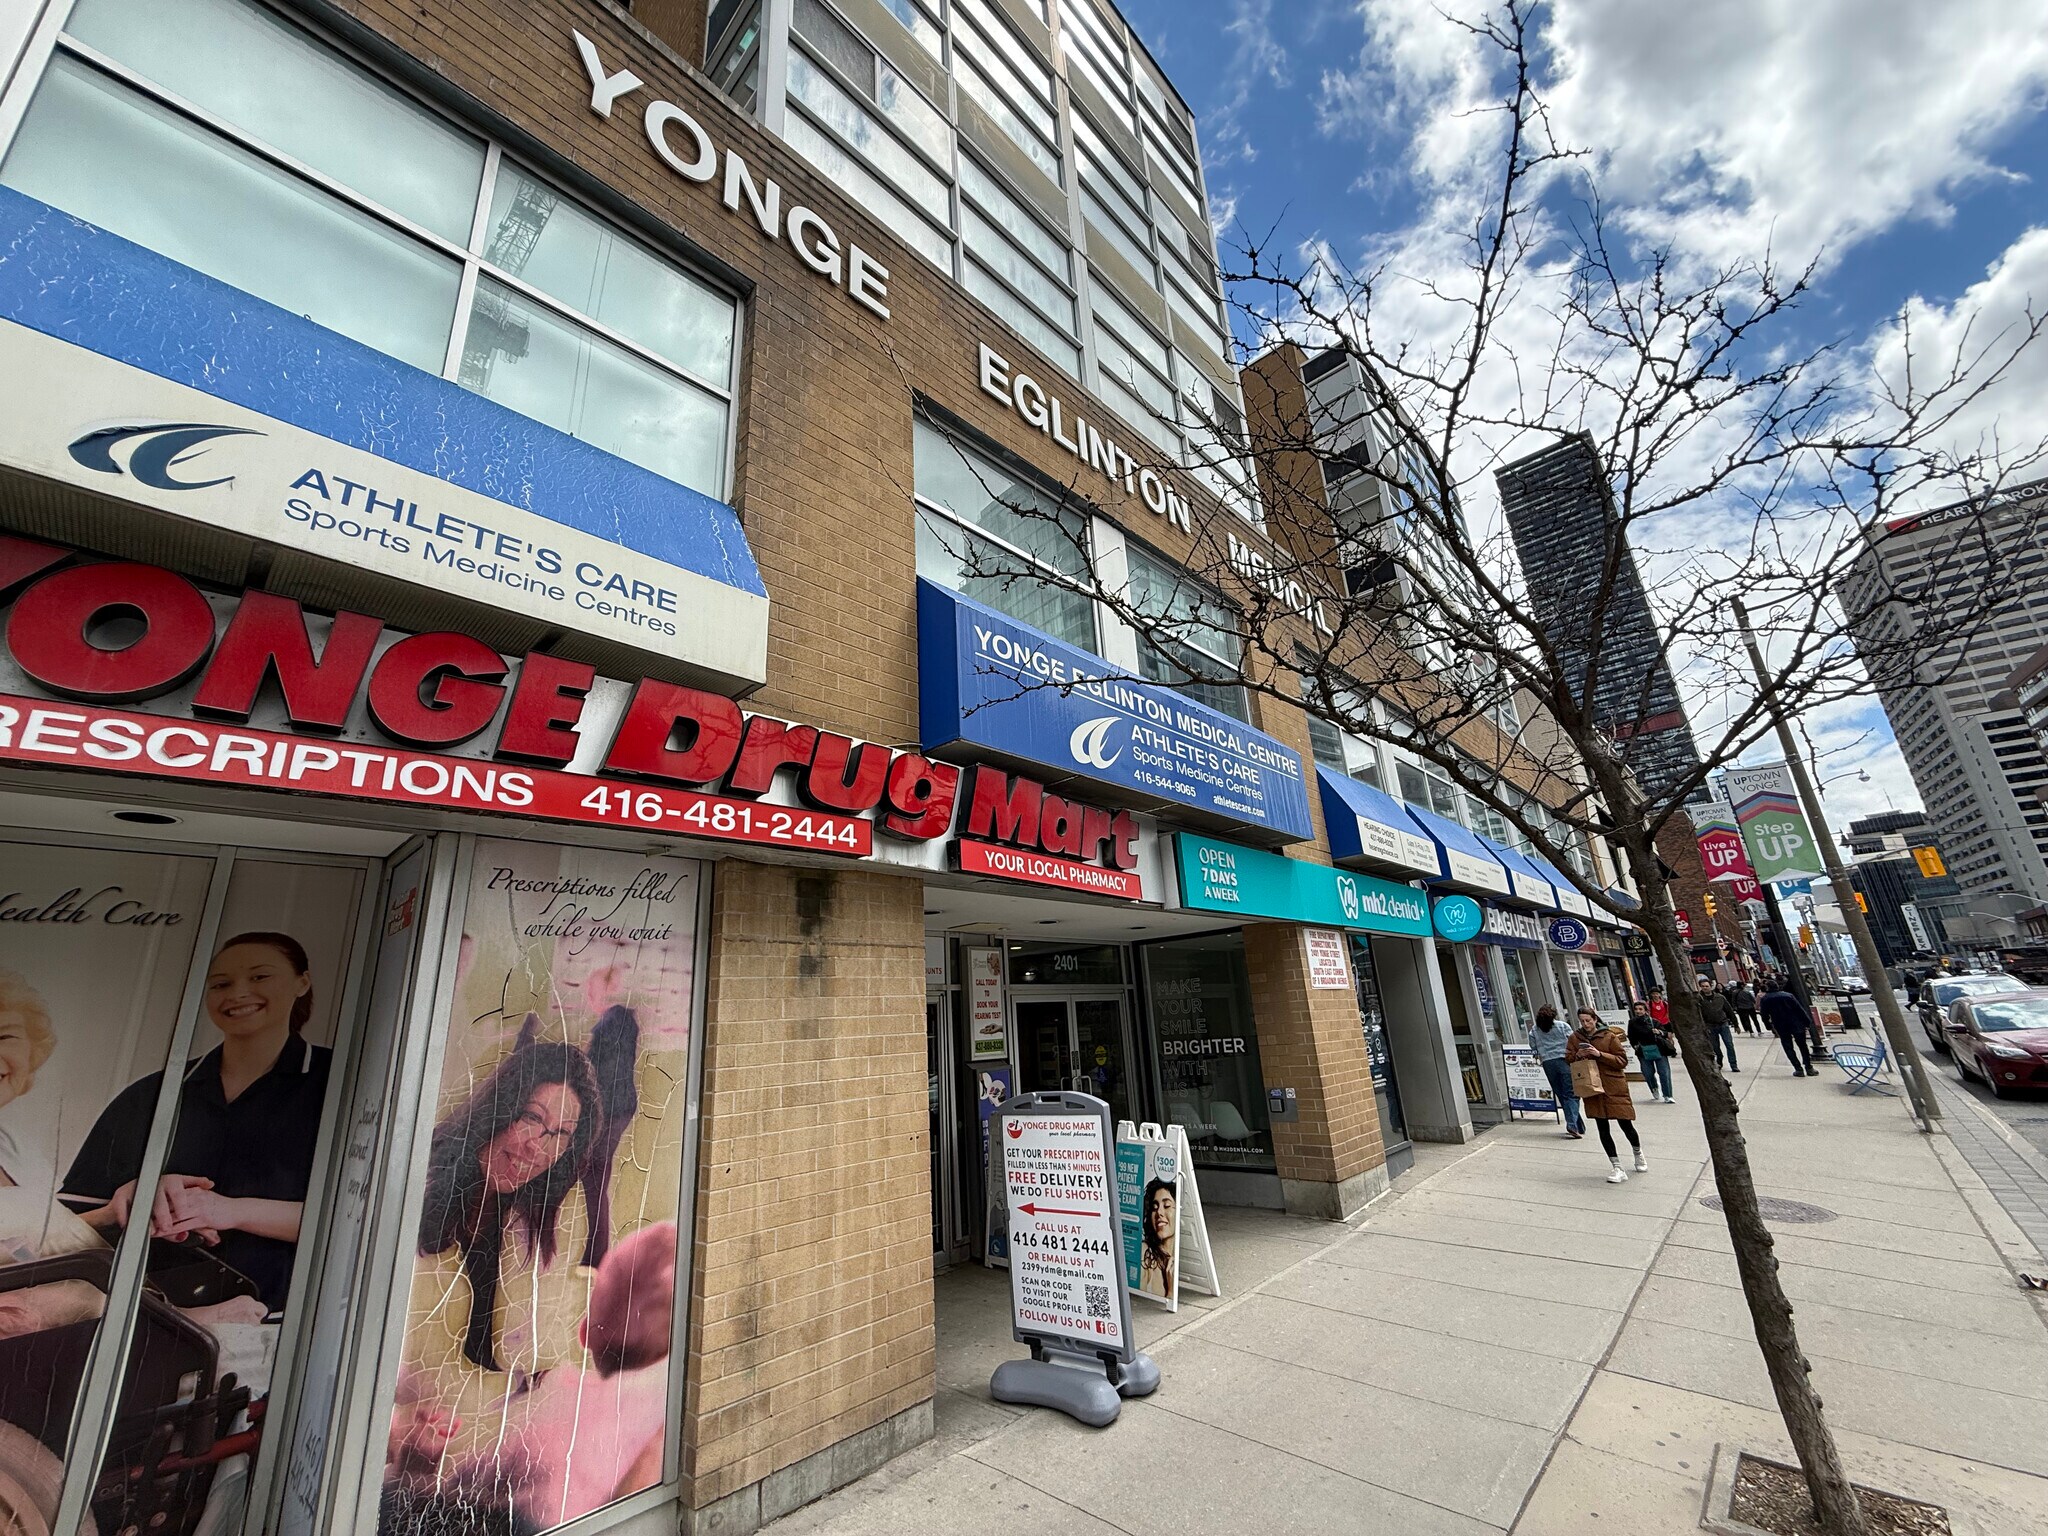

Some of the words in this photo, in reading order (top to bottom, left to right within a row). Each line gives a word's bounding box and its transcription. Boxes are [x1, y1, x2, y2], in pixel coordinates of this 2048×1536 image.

[572, 28, 891, 320] YONGE
[979, 341, 1191, 534] EGLINTON
[289, 468, 561, 574] ATHLETE'S
[574, 562, 678, 614] CARE
[284, 498, 410, 554] Sports
[423, 541, 565, 600] Medicine
[575, 590, 677, 636] Centres
[973, 625, 1065, 680] YONGE
[1072, 667, 1173, 726] EGLINTON
[1177, 711, 1245, 755] MEDICAL
[1248, 742, 1299, 777] CENTRE
[1131, 724, 1218, 771] ATHLETE'S
[1222, 758, 1261, 785] CARE
[600, 675, 960, 843] Drug
[957, 764, 1140, 871] Mart
[1133, 747, 1173, 772] Sports
[1176, 763, 1224, 788] Medicine
[1226, 777, 1264, 801] Centres
[1734, 771, 1781, 786] UPTOWN
[1133, 770, 1196, 798] 416-544-9065
[1740, 781, 1781, 793] YONGE
[1213, 795, 1265, 819] athletescare.com
[1696, 807, 1727, 817] UPTOWN
[580, 786, 859, 848] 416-481-2444
[1754, 823, 1795, 836] Step
[1704, 841, 1726, 851] Live
[1729, 840, 1737, 848] it
[1756, 834, 1803, 861] UP
[1199, 847, 1236, 869] OPEN
[1708, 849, 1738, 867] UP
[985, 850, 1025, 873] YOUR
[1028, 860, 1068, 881] LOCAL
[1070, 869, 1127, 892] PHARMACY
[1201, 868, 1209, 881] 7
[1210, 869, 1238, 886] DAYS
[487, 867, 616, 915] Prescriptions
[592, 868, 688, 922] filled
[1205, 886, 1213, 898] A
[1212, 887, 1240, 902] WEEK
[1736, 881, 1757, 894] UP
[0, 886, 123, 924] ealth
[104, 900, 183, 926] Care
[1362, 891, 1388, 916] mh2
[524, 903, 588, 938] while
[569, 924, 625, 956] you
[629, 924, 673, 941] wait
[1486, 907, 1544, 941] BAGUETTE
[1054, 954, 1079, 971] 2401
[976, 978, 985, 986] CALL
[986, 978, 998, 986] TODAY
[1157, 978, 1202, 996] MAKE
[976, 1001, 987, 1009] BOOK
[1157, 998, 1203, 1015] YOUR
[975, 1012, 991, 1020] HEARING
[992, 1011, 1001, 1019] TEST
[1161, 1018, 1208, 1036] SMILE
[1163, 1037, 1246, 1056] BRIGHTER
[1165, 1060, 1208, 1078] WITH
[1166, 1081, 1189, 1097] US
[1022, 1121, 1048, 1130] YONGE
[1049, 1122, 1071, 1130] DRUG
[1073, 1122, 1095, 1131] MART
[1006, 1148, 1020, 1158] GET
[1022, 1148, 1042, 1158] YOUR
[1044, 1149, 1100, 1160] PRESCRIPTION
[1156, 1155, 1175, 1166] $300
[1007, 1161, 1026, 1169] FILLED
[1027, 1161, 1034, 1169] IN
[1035, 1162, 1048, 1170] LESS
[1049, 1162, 1066, 1171] THAN
[1067, 1163, 1072, 1171] 5
[1073, 1164, 1101, 1172] MINUTES
[1127, 1162, 1139, 1174] NEW
[1158, 1165, 1175, 1173] VALUE
[1008, 1171, 1037, 1184] FREE
[1040, 1172, 1103, 1188] DELIVERY
[1117, 1172, 1138, 1183] PATIENT
[1010, 1186, 1025, 1195] WE
[1028, 1186, 1042, 1196] DO
[1044, 1188, 1063, 1198] FLU
[1065, 1188, 1103, 1201] SHOTS!
[1122, 1194, 1137, 1205] EXAM
[1035, 1222, 1056, 1232] CALL
[1057, 1224, 1069, 1233] US
[1070, 1225, 1082, 1235] AT
[1013, 1231, 1037, 1247] 416
[1042, 1234, 1068, 1251] 481
[1072, 1237, 1109, 1255] 2444
[1027, 1251, 1040, 1261] OR
[1041, 1253, 1068, 1265] EMAIL
[1070, 1257, 1082, 1267] US
[1084, 1259, 1095, 1268] AT
[1021, 1261, 1105, 1281] 2399ydm@gmail.com
[1021, 1276, 1040, 1286] SCAN
[1041, 1279, 1051, 1289] QR
[1053, 1280, 1073, 1291] CODE
[1022, 1286, 1032, 1295] TO
[1032, 1288, 1051, 1298] VISIT
[1052, 1291, 1068, 1301] OUR
[1022, 1296, 1051, 1309] GOOGLE
[1052, 1301, 1083, 1314] PROFILE
[1019, 1308, 1058, 1324] FOLLOW
[1060, 1316, 1073, 1327] US
[1076, 1319, 1091, 1331] ON
